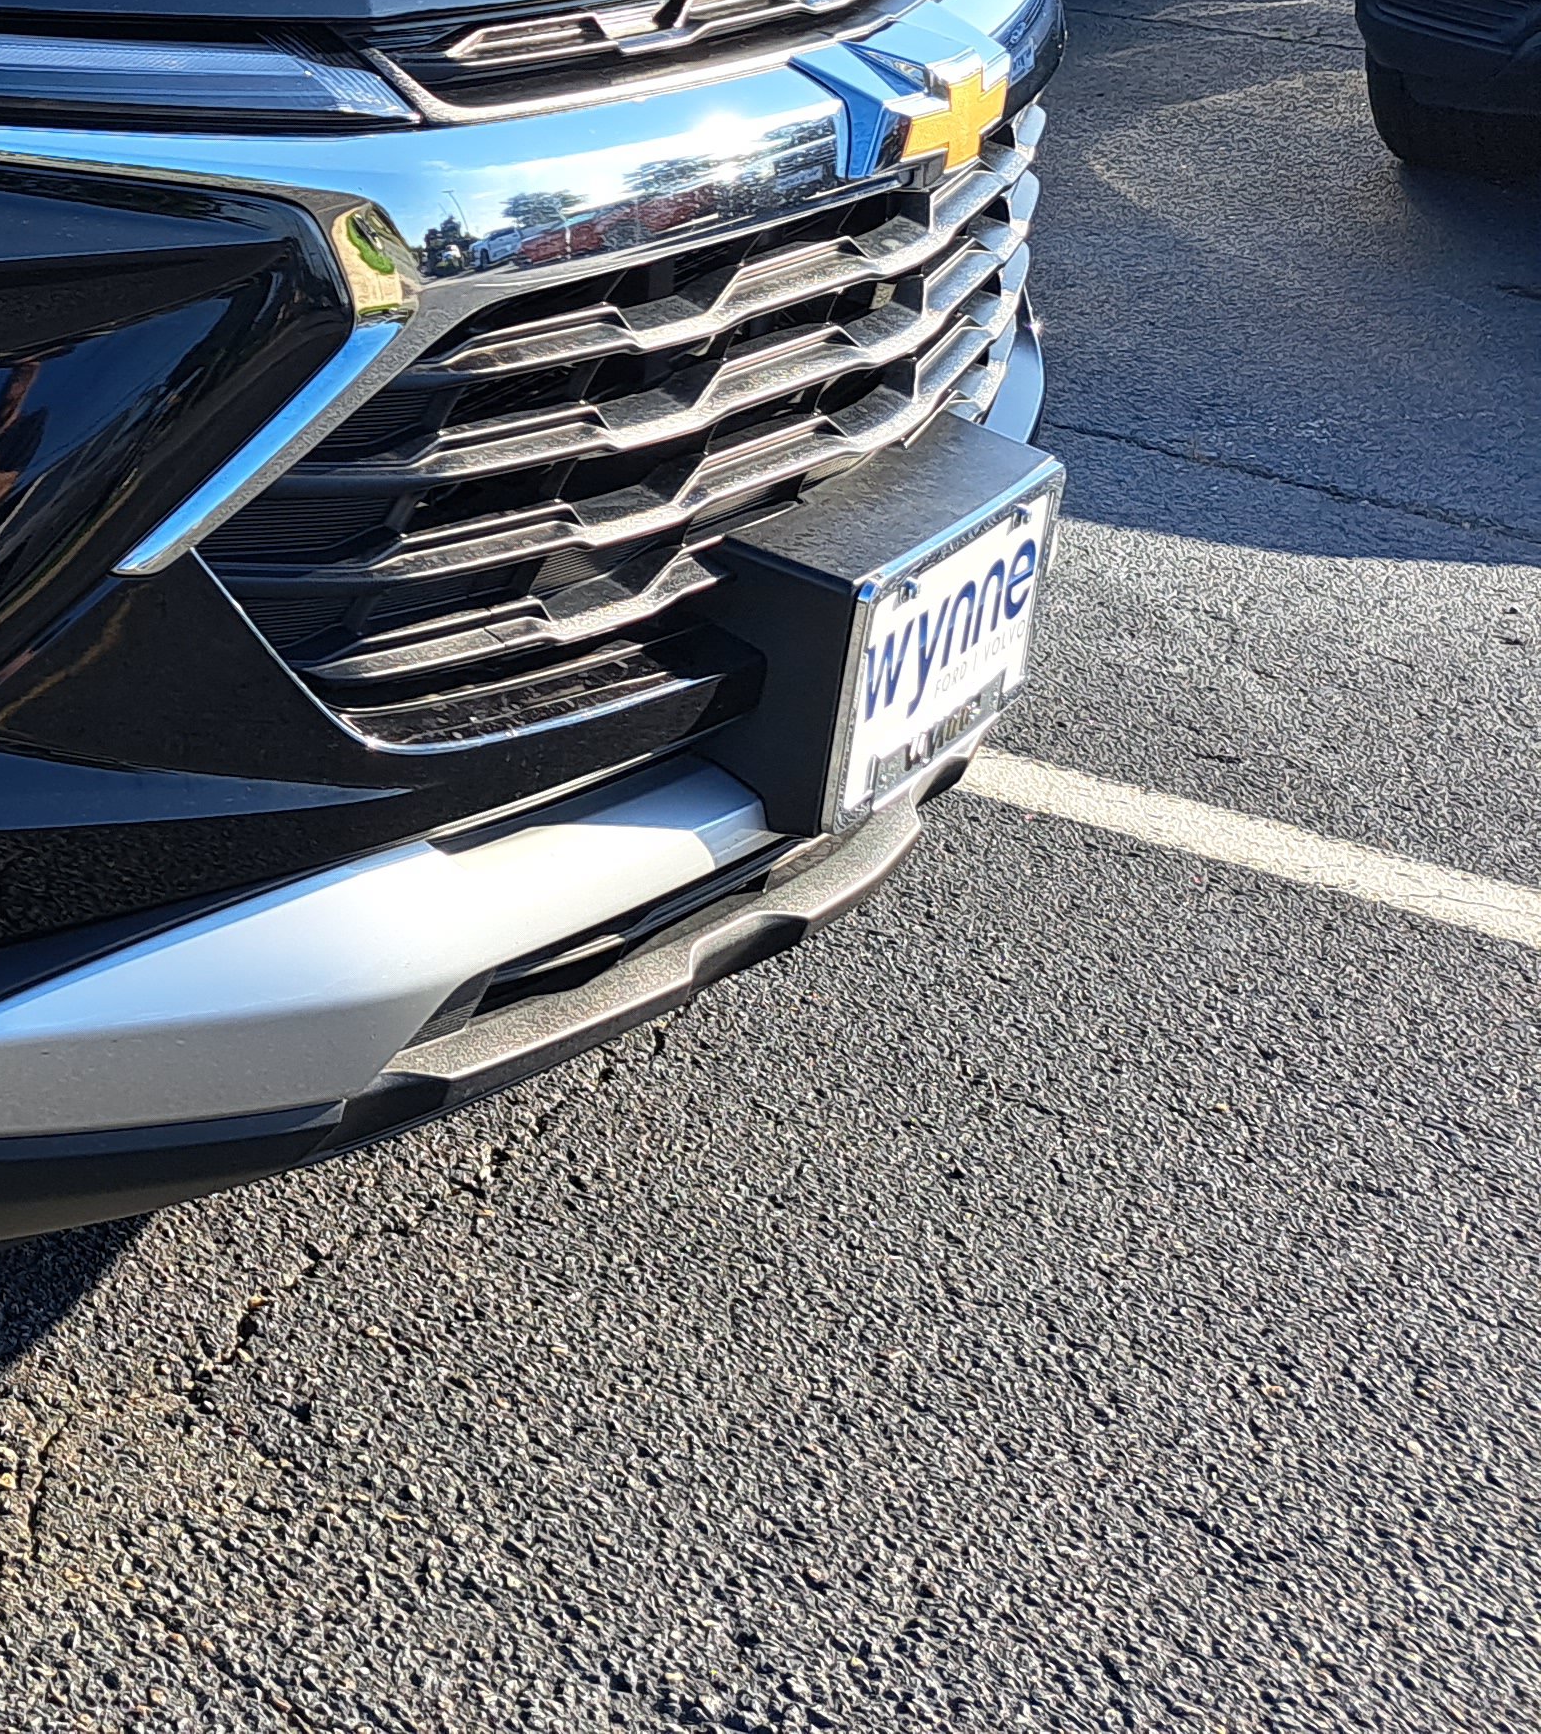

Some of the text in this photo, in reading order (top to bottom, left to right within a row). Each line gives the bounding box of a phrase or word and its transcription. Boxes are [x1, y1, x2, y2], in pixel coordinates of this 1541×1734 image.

[864, 537, 1037, 723] wynne
[935, 618, 1026, 699] FORD VOLVO
